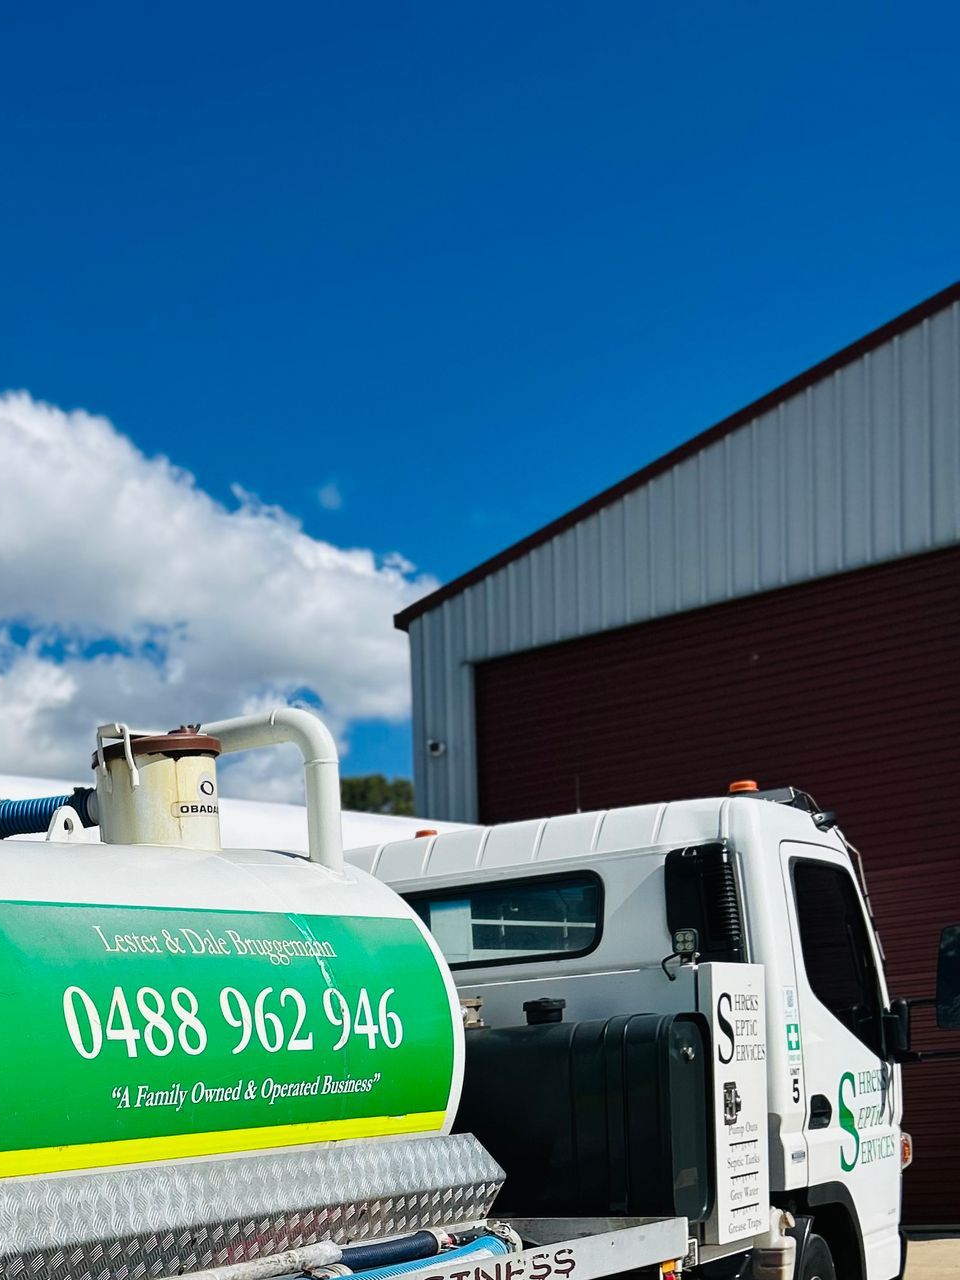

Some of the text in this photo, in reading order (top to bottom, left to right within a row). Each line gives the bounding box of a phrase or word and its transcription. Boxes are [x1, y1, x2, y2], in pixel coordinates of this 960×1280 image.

[93, 926, 338, 966] Lester & Dale Bruggemann
[62, 985, 404, 1060] 0488 962 946
[134, 1083, 189, 1112] Family
[191, 1079, 241, 1105] Owned
[244, 1080, 258, 1101] &
[261, 1076, 320, 1107] Operated
[792, 1078, 800, 1104] 5
[728, 1217, 762, 1234] Grease Traps
